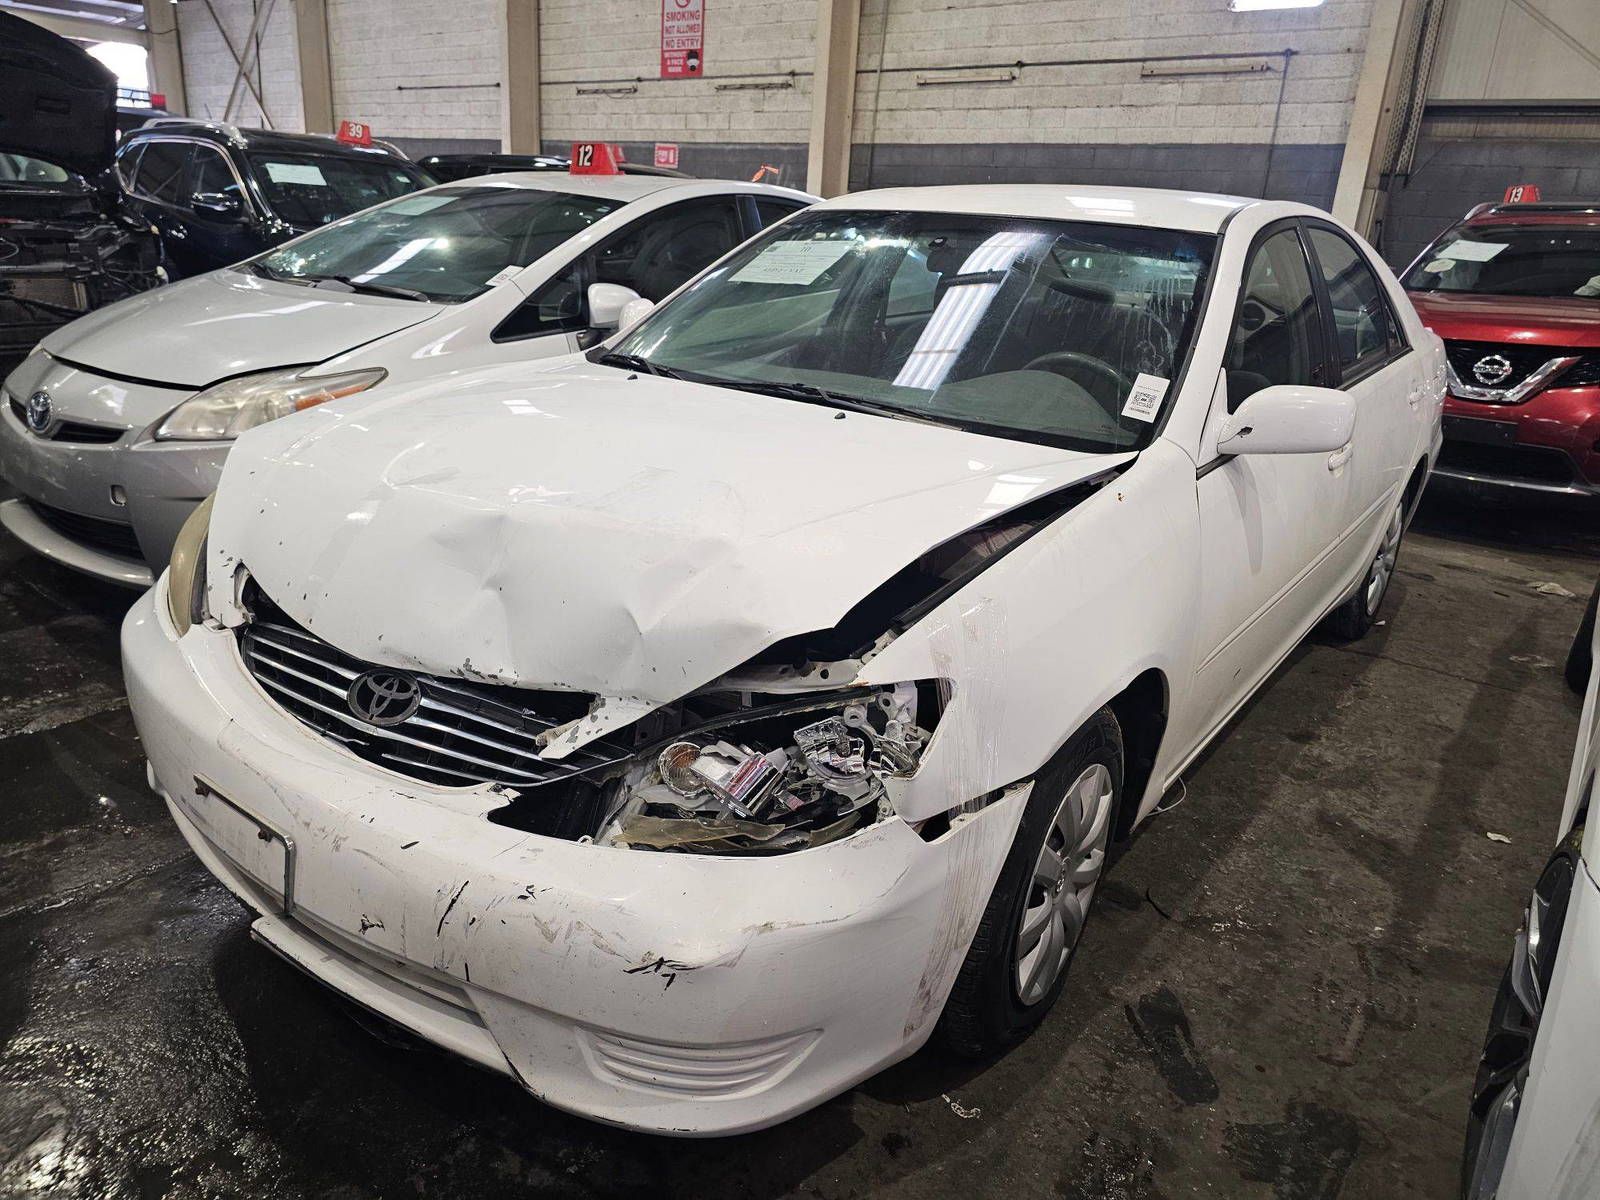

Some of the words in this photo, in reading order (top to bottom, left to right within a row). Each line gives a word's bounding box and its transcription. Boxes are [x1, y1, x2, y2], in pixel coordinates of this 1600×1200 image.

[666, 10, 700, 22] SMOKING
[666, 39, 675, 48] NO
[677, 39, 699, 48] ENTRY
[349, 123, 362, 138] 39
[579, 145, 593, 166] 12
[1510, 187, 1523, 203] 13
